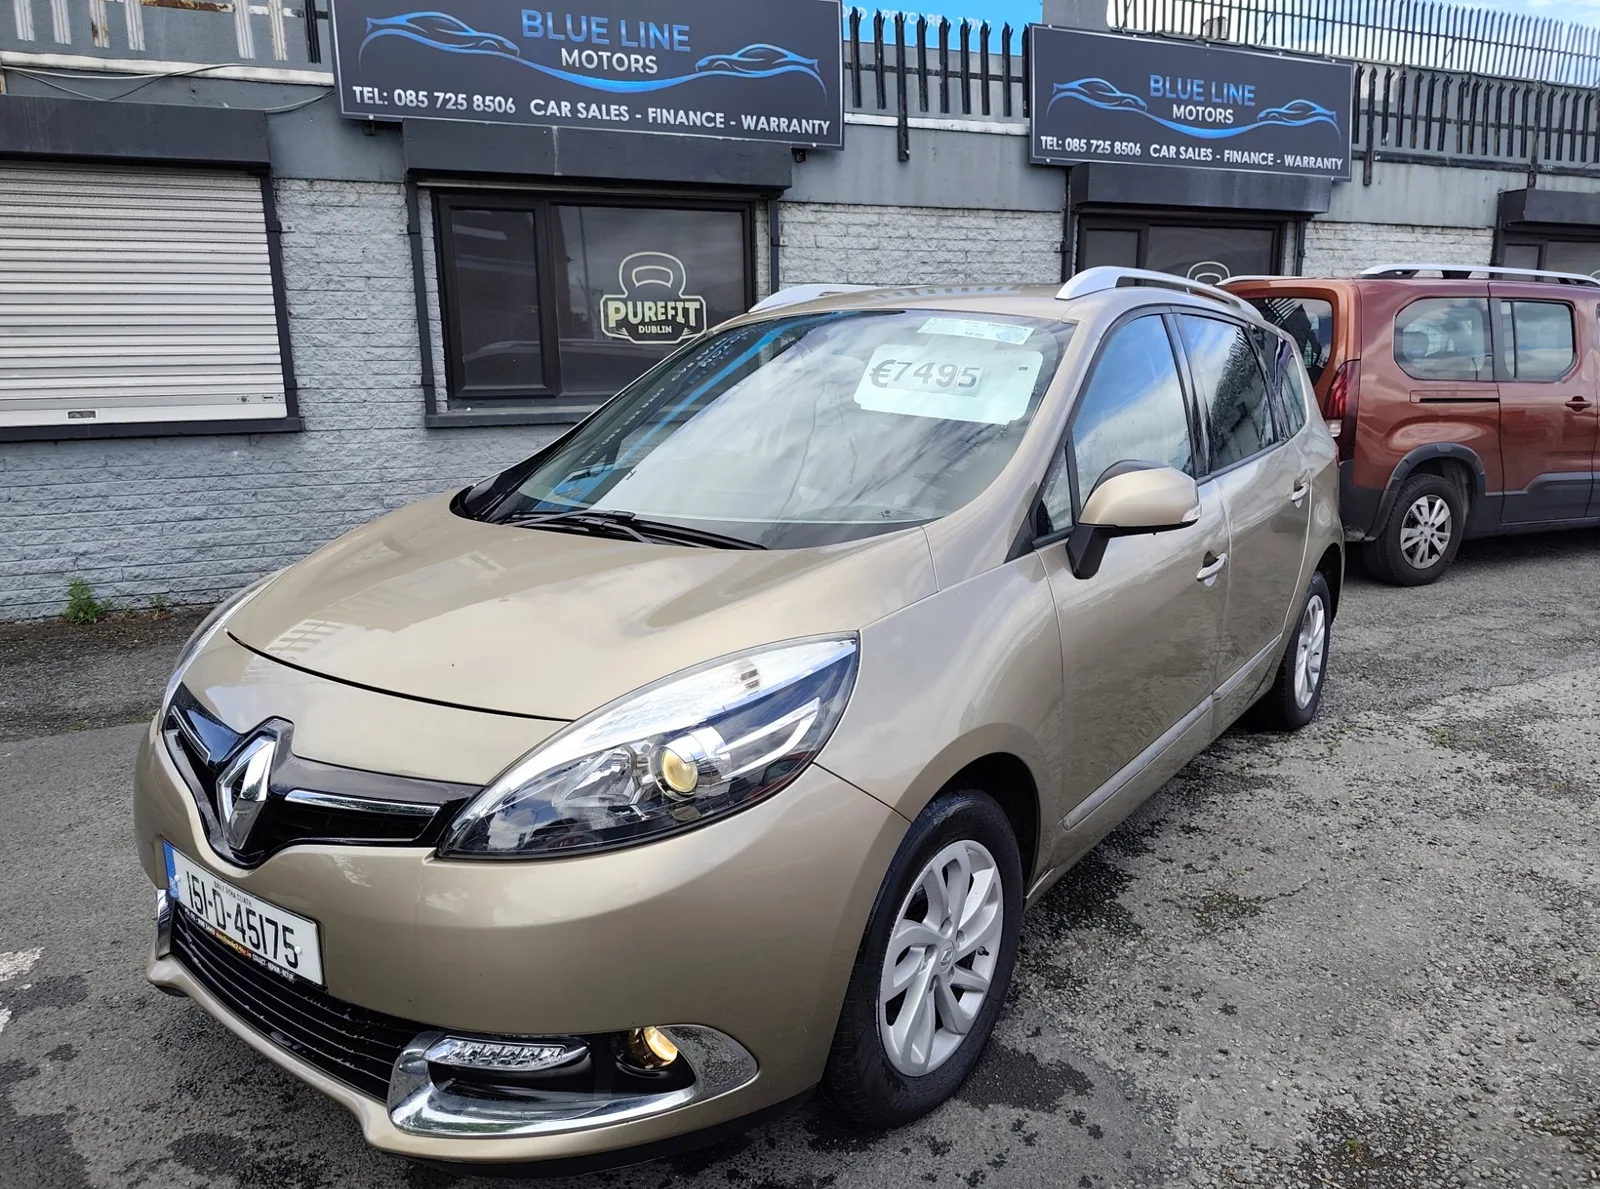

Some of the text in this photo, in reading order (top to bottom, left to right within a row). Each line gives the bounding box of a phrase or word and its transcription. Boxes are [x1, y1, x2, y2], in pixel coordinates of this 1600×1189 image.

[521, 9, 691, 52] BLUE LINE
[561, 47, 658, 75] MOTORS
[353, 86, 516, 114] TEL: 085 725 8506
[1149, 75, 1256, 106] BLUE LINE
[530, 98, 571, 119] CAR
[577, 101, 629, 122] SALES
[648, 106, 725, 129] FINANCE
[741, 114, 831, 136] WARRANTY
[1172, 104, 1234, 124] MOTORS
[1040, 136, 1141, 156] TEL: 085 725 8506
[1150, 143, 1176, 159] CAR
[1179, 146, 1213, 162] SALES
[1224, 150, 1274, 166] FINANCE
[1284, 154, 1343, 170] WARRANTY
[607, 301, 700, 327] PUREFIT
[638, 325, 672, 333] DUBLIN
[869, 359, 980, 388] €7495
[186, 871, 299, 970] 151-D-45175
